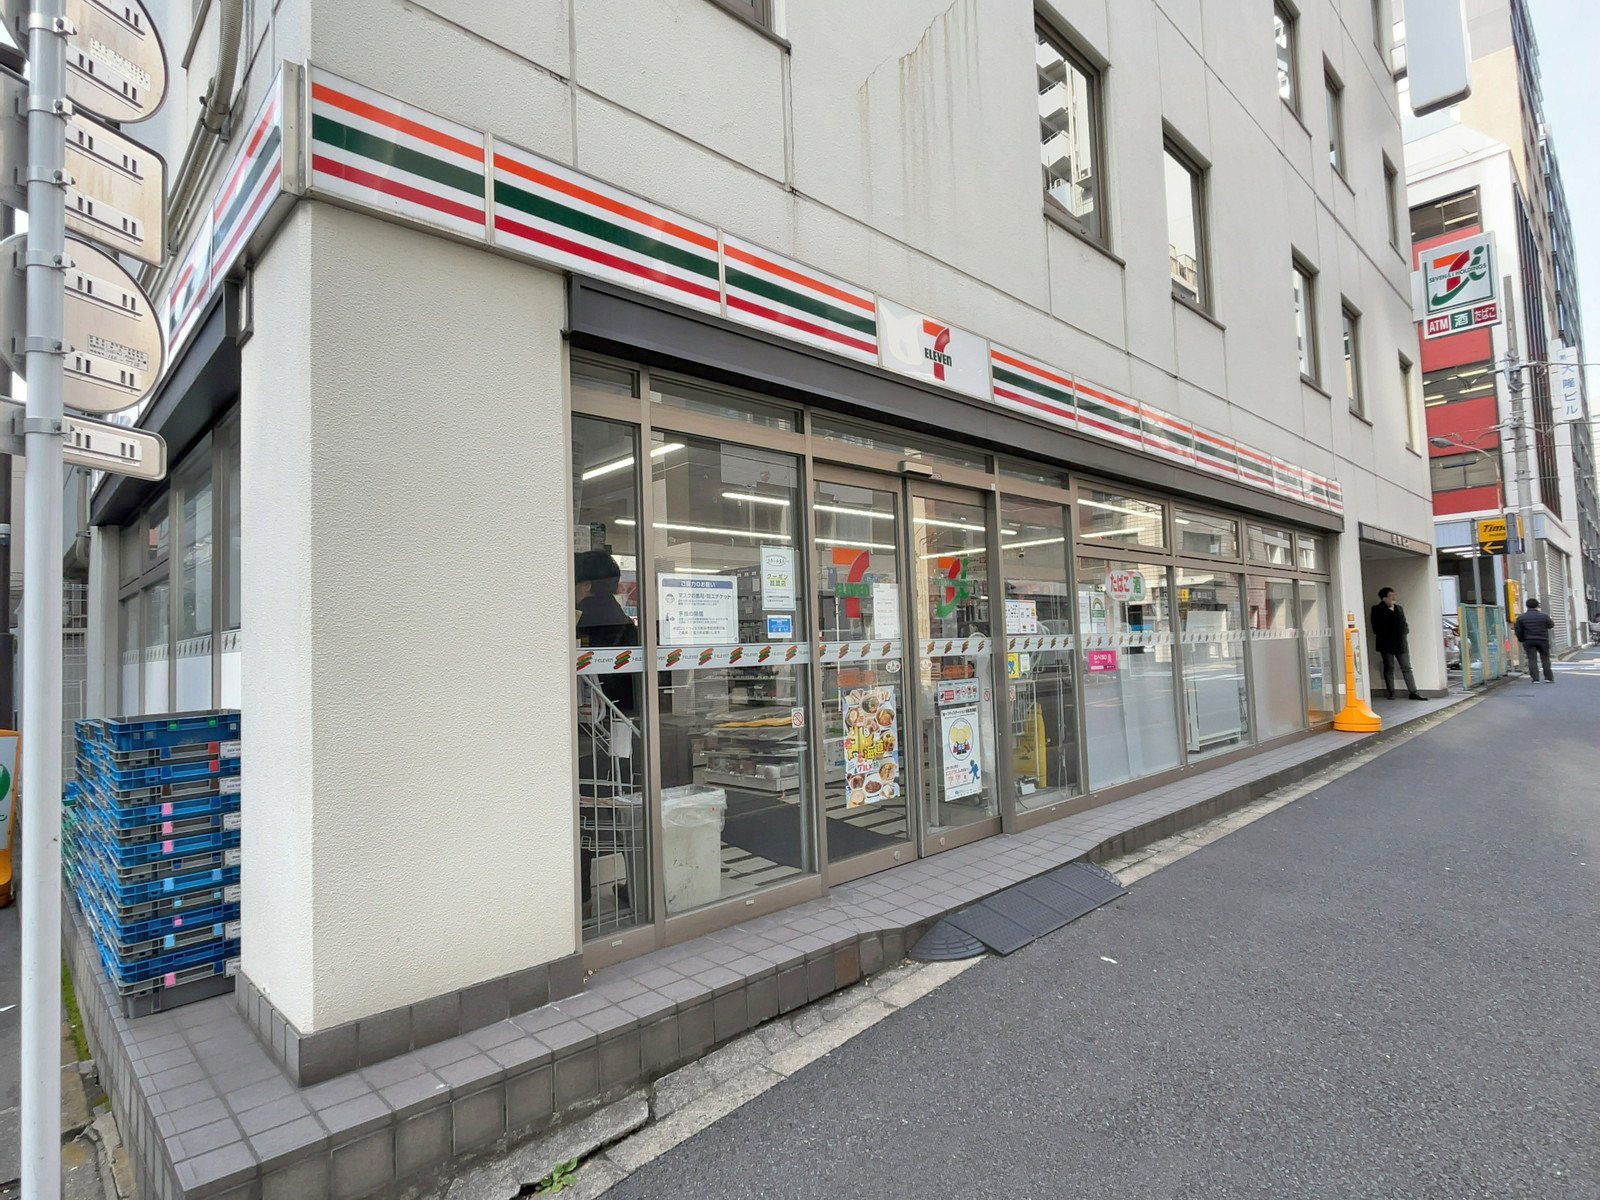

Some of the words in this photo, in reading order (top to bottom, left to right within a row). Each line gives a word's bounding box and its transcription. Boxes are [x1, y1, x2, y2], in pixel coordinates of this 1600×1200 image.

[1454, 312, 1469, 328] 酒
[1474, 306, 1496, 321] たばこ
[1429, 317, 1449, 333] ATM
[1110, 574, 1130, 592] たばこ
[1133, 576, 1142, 593] 酒
